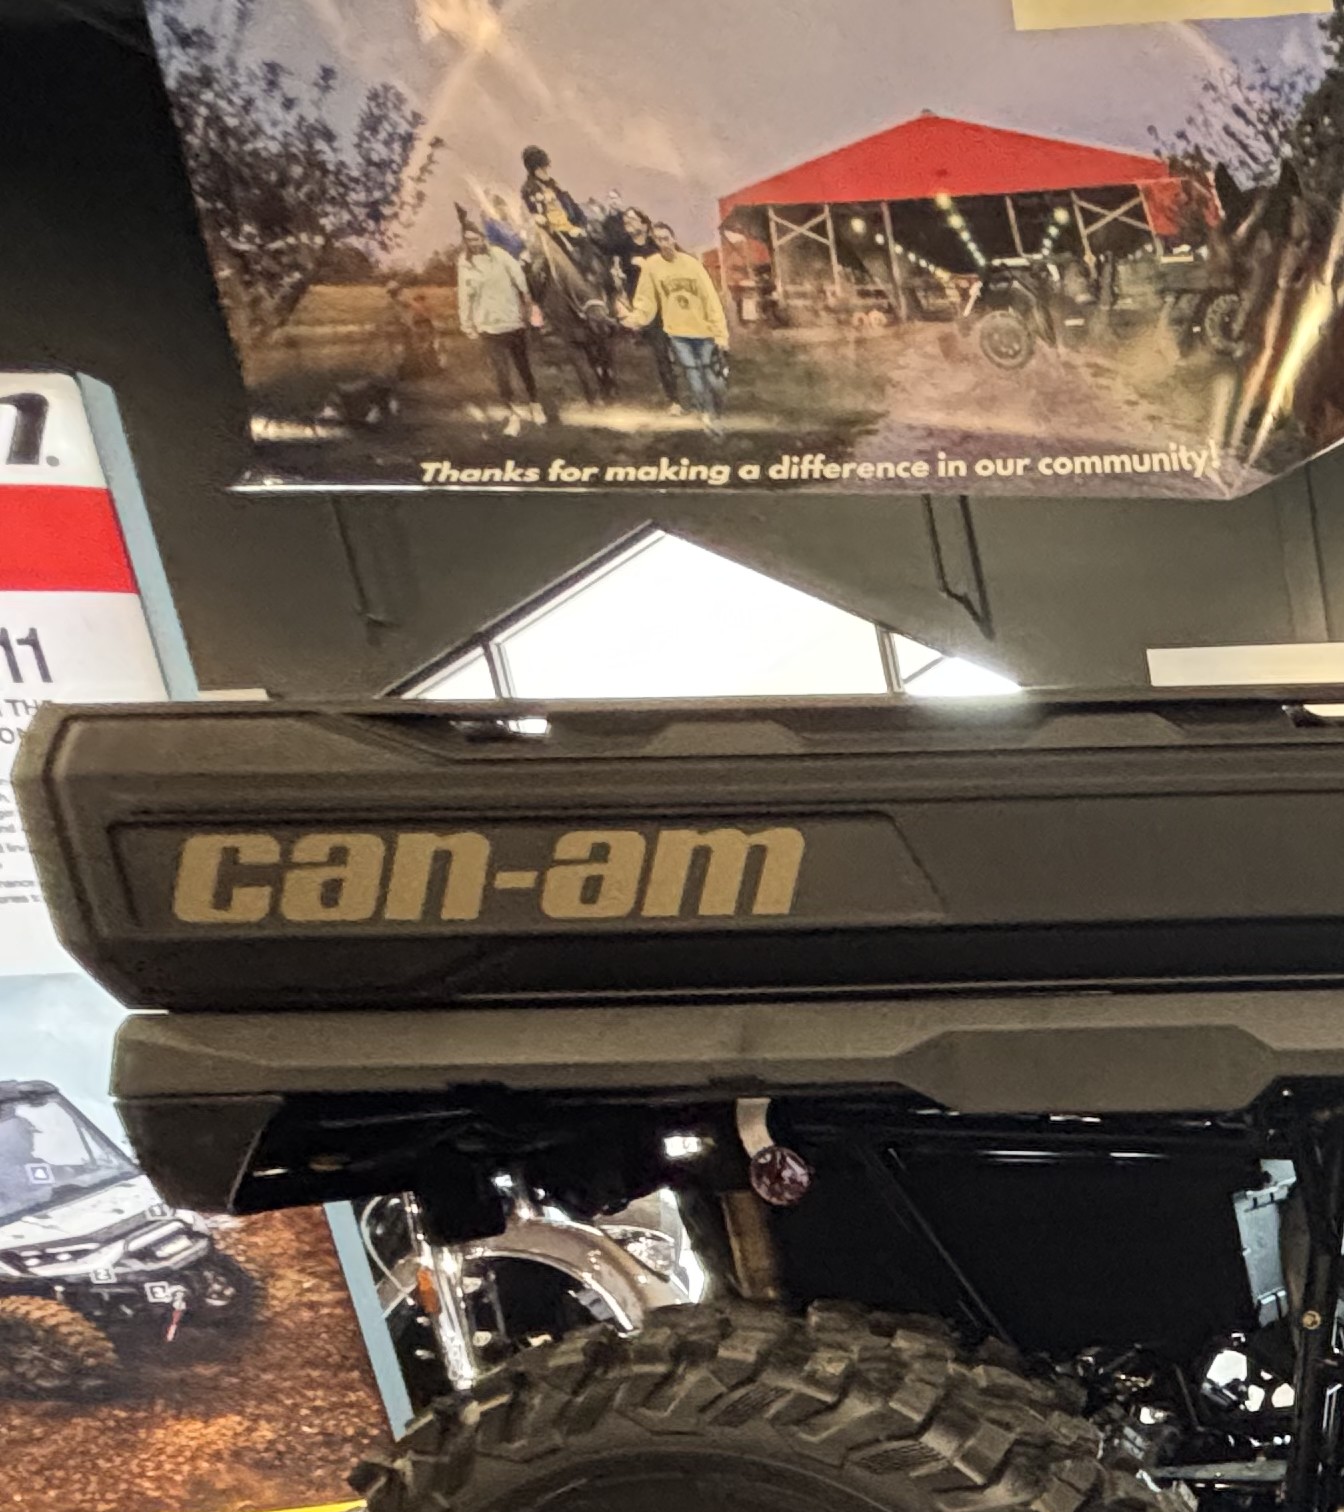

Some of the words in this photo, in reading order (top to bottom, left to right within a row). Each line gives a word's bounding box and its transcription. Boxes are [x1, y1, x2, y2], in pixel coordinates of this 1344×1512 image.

[420, 459, 540, 483] Thanks
[548, 458, 599, 482] for
[605, 457, 730, 485] making
[738, 462, 761, 480] a
[768, 453, 929, 482] difference
[937, 451, 967, 477] in
[975, 457, 1030, 477] our
[1038, 439, 1221, 478] community!
[172, 827, 805, 922] can-am
